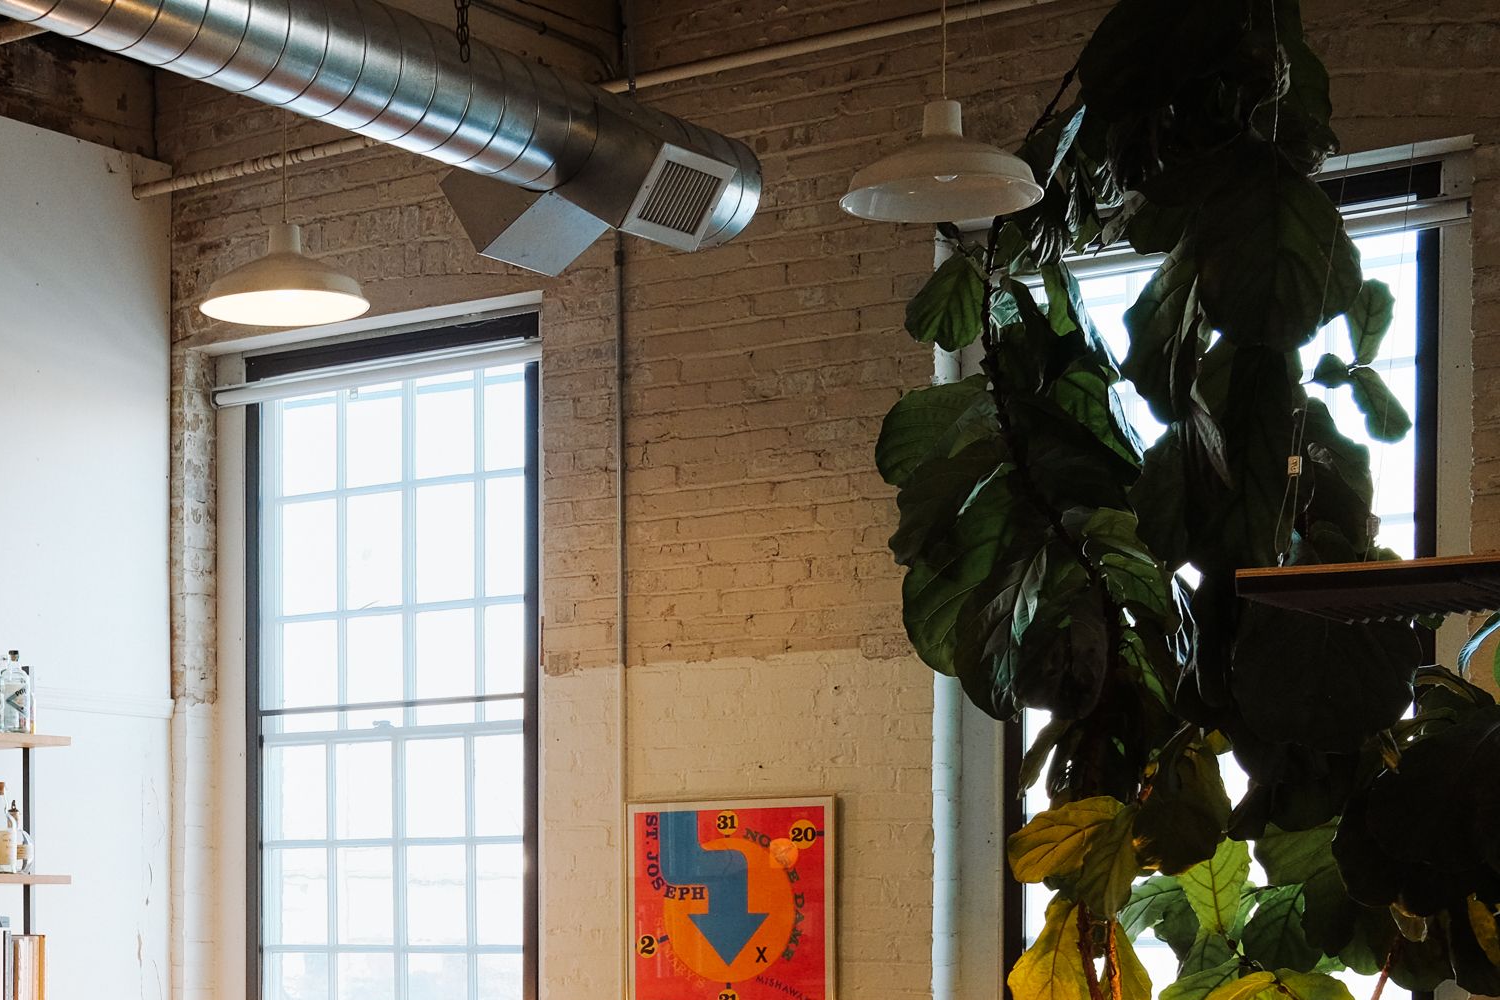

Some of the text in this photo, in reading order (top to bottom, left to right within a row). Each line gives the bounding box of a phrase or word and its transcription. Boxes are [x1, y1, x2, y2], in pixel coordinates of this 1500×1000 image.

[717, 815, 736, 830] 31
[791, 826, 816, 842] 20
[645, 814, 706, 901] ST. JOSEPH
[742, 828, 805, 961] NOE DAME
[640, 935, 655, 955] 2
[755, 946, 767, 963] X
